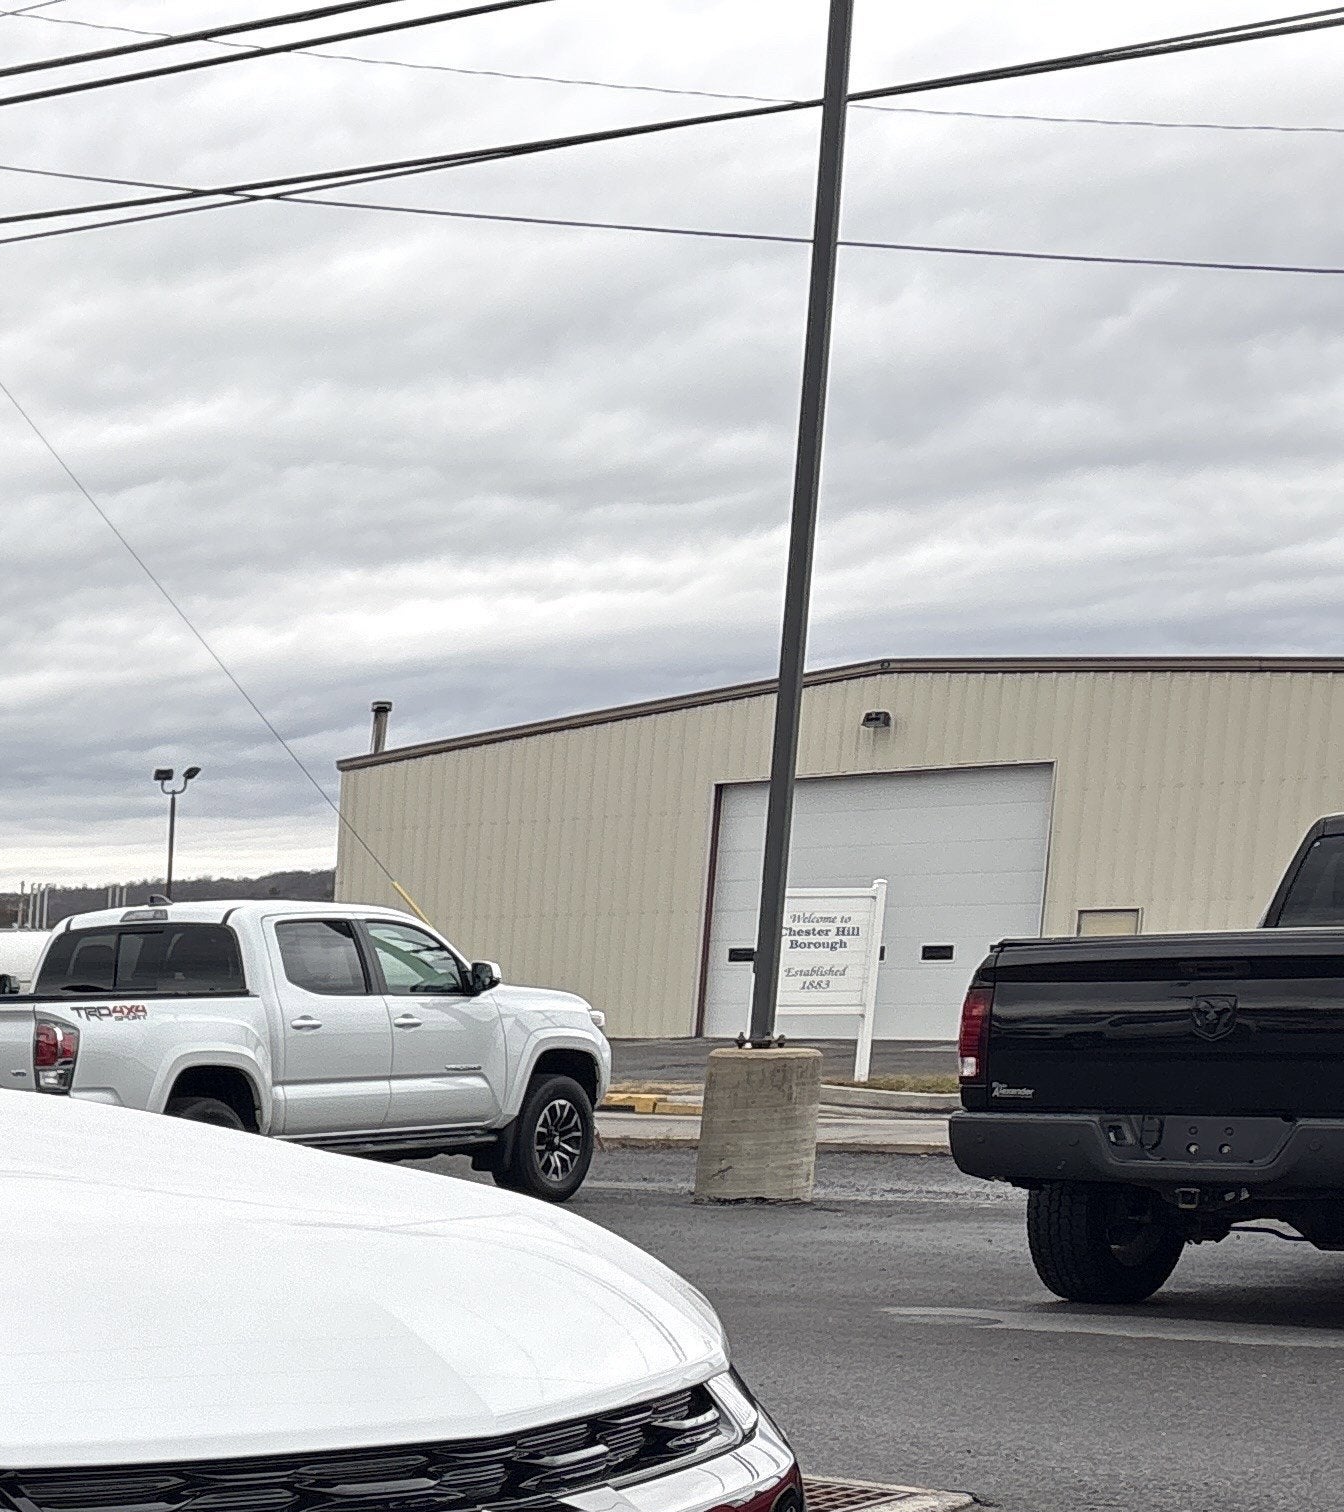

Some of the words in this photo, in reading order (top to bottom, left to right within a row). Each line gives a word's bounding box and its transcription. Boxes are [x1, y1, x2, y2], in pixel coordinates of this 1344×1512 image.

[789, 912, 838, 924] Welcome
[840, 914, 852, 924] to
[834, 926, 860, 937] Hill
[789, 939, 848, 951] Borough
[784, 964, 848, 978] Established
[70, 1006, 112, 1021] TRD
